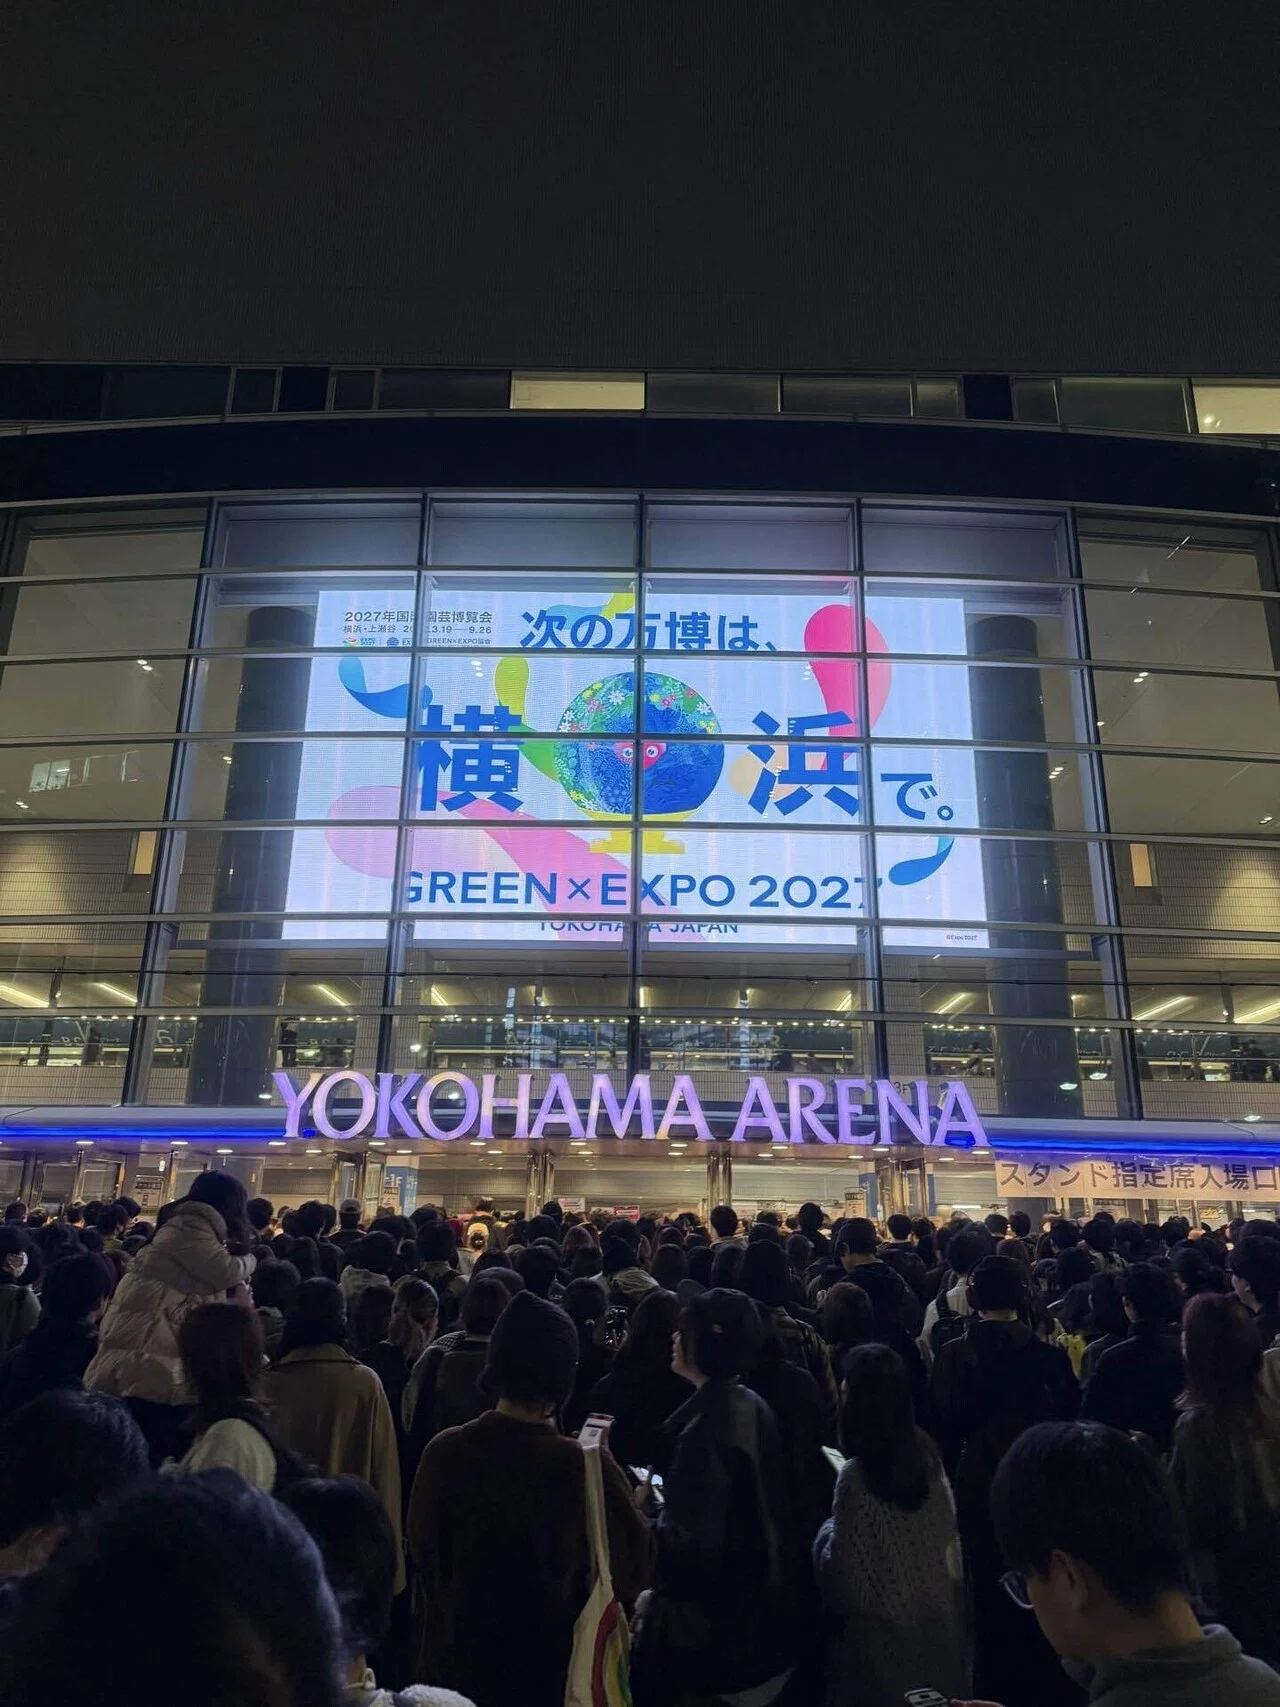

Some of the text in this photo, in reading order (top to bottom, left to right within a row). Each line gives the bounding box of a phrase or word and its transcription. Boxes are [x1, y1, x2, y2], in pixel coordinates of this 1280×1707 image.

[520, 609, 776, 650] 次の万博は、
[272, 1070, 993, 1147] YOKOHAMA ARENA
[1000, 1160, 1278, 1191] スタンド指定席入場口
